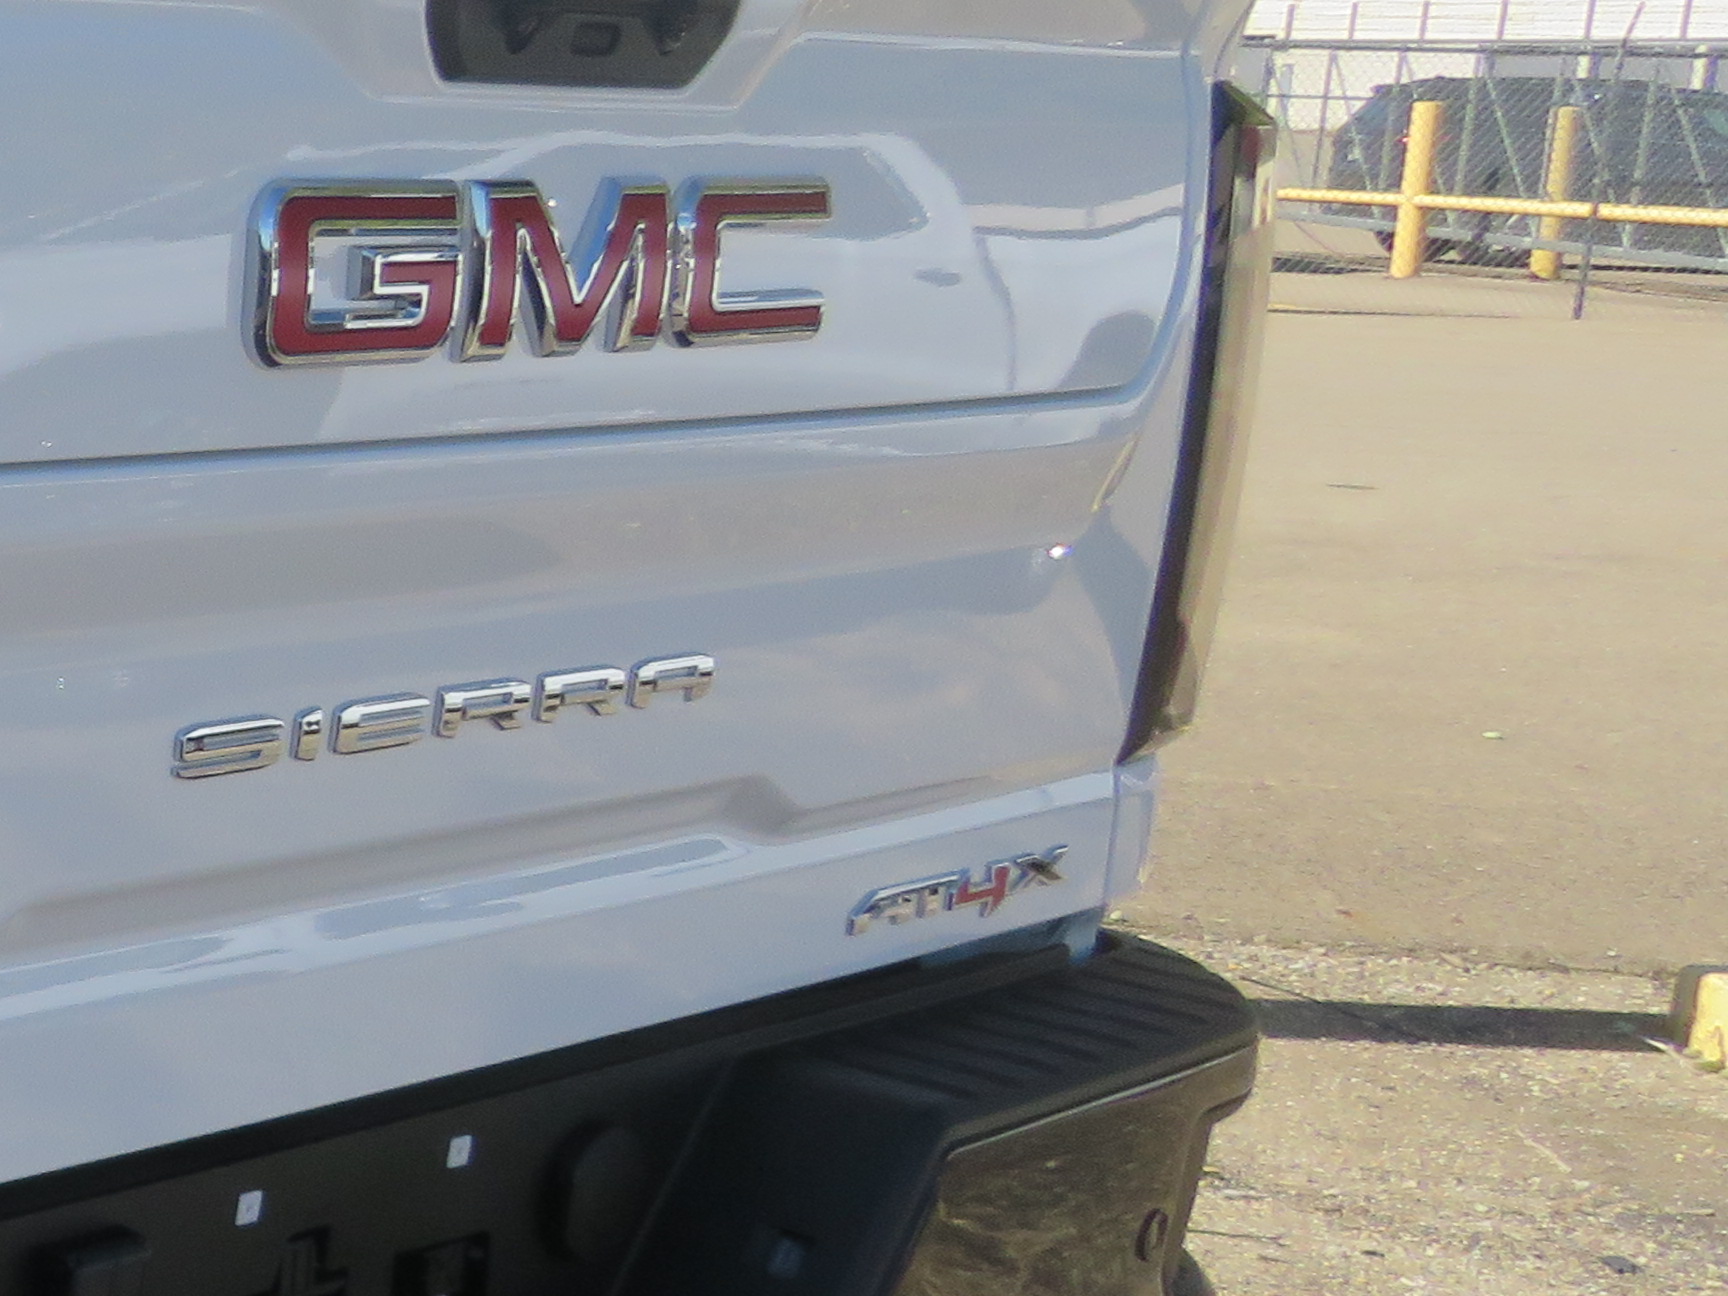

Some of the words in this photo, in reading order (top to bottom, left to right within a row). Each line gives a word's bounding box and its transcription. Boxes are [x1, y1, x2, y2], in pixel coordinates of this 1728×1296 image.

[247, 178, 831, 365] GMC
[171, 651, 716, 779] SIERRA
[846, 844, 1069, 935] AT4X
